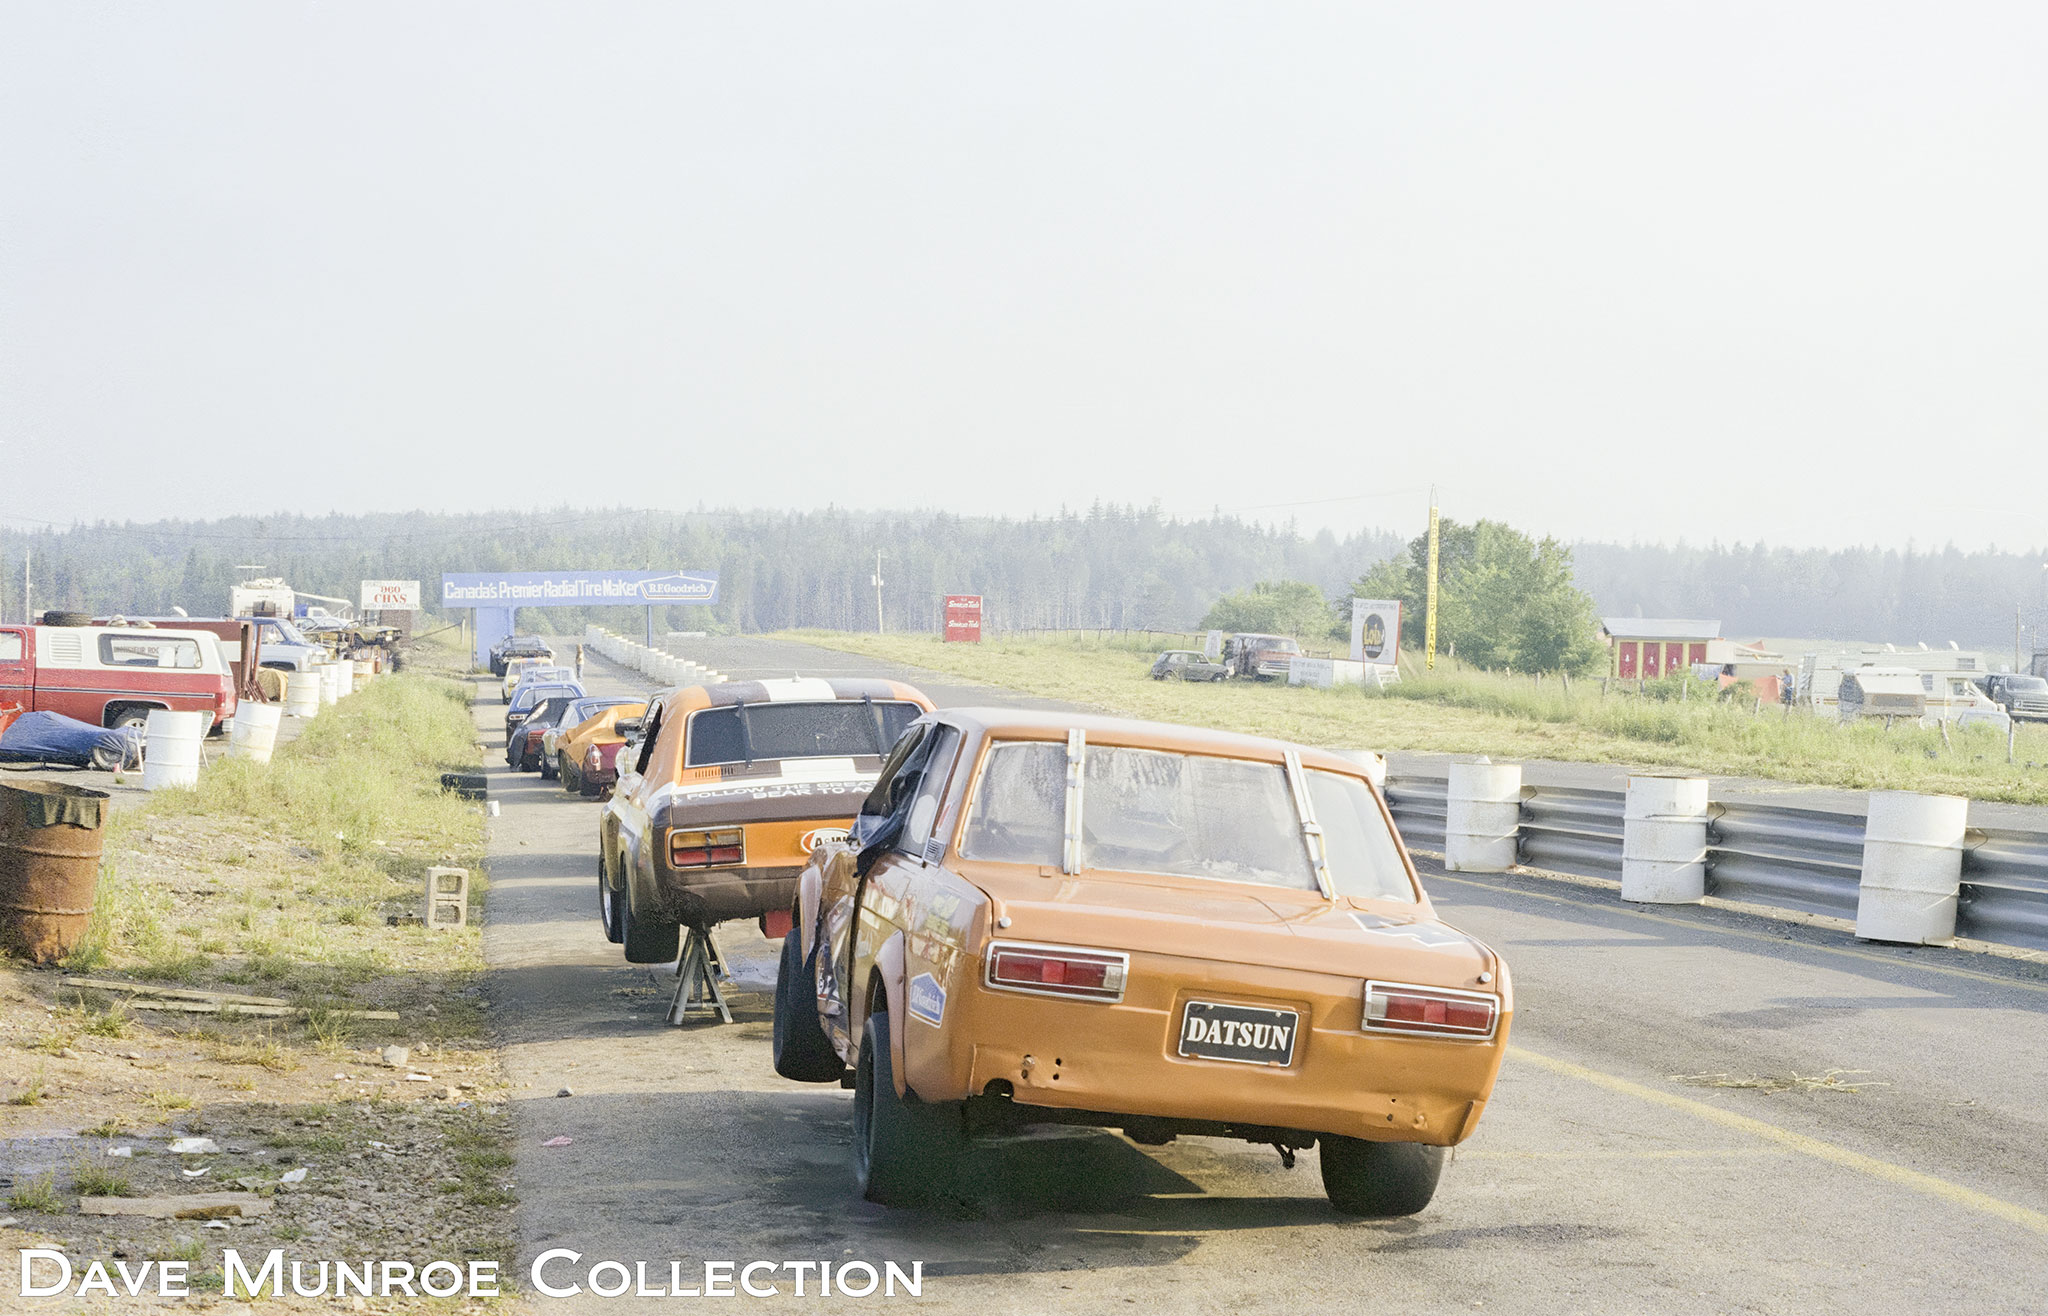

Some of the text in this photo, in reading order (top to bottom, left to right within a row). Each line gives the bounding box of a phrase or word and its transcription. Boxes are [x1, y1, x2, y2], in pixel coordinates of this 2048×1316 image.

[444, 580, 639, 599] Canada's Premier Radial Tire Maker
[374, 594, 408, 604] CHNS
[686, 786, 765, 800] FOLLOW
[771, 783, 811, 791] THE
[753, 788, 812, 799] BEAR
[1186, 1017, 1291, 1052] DATSUN
